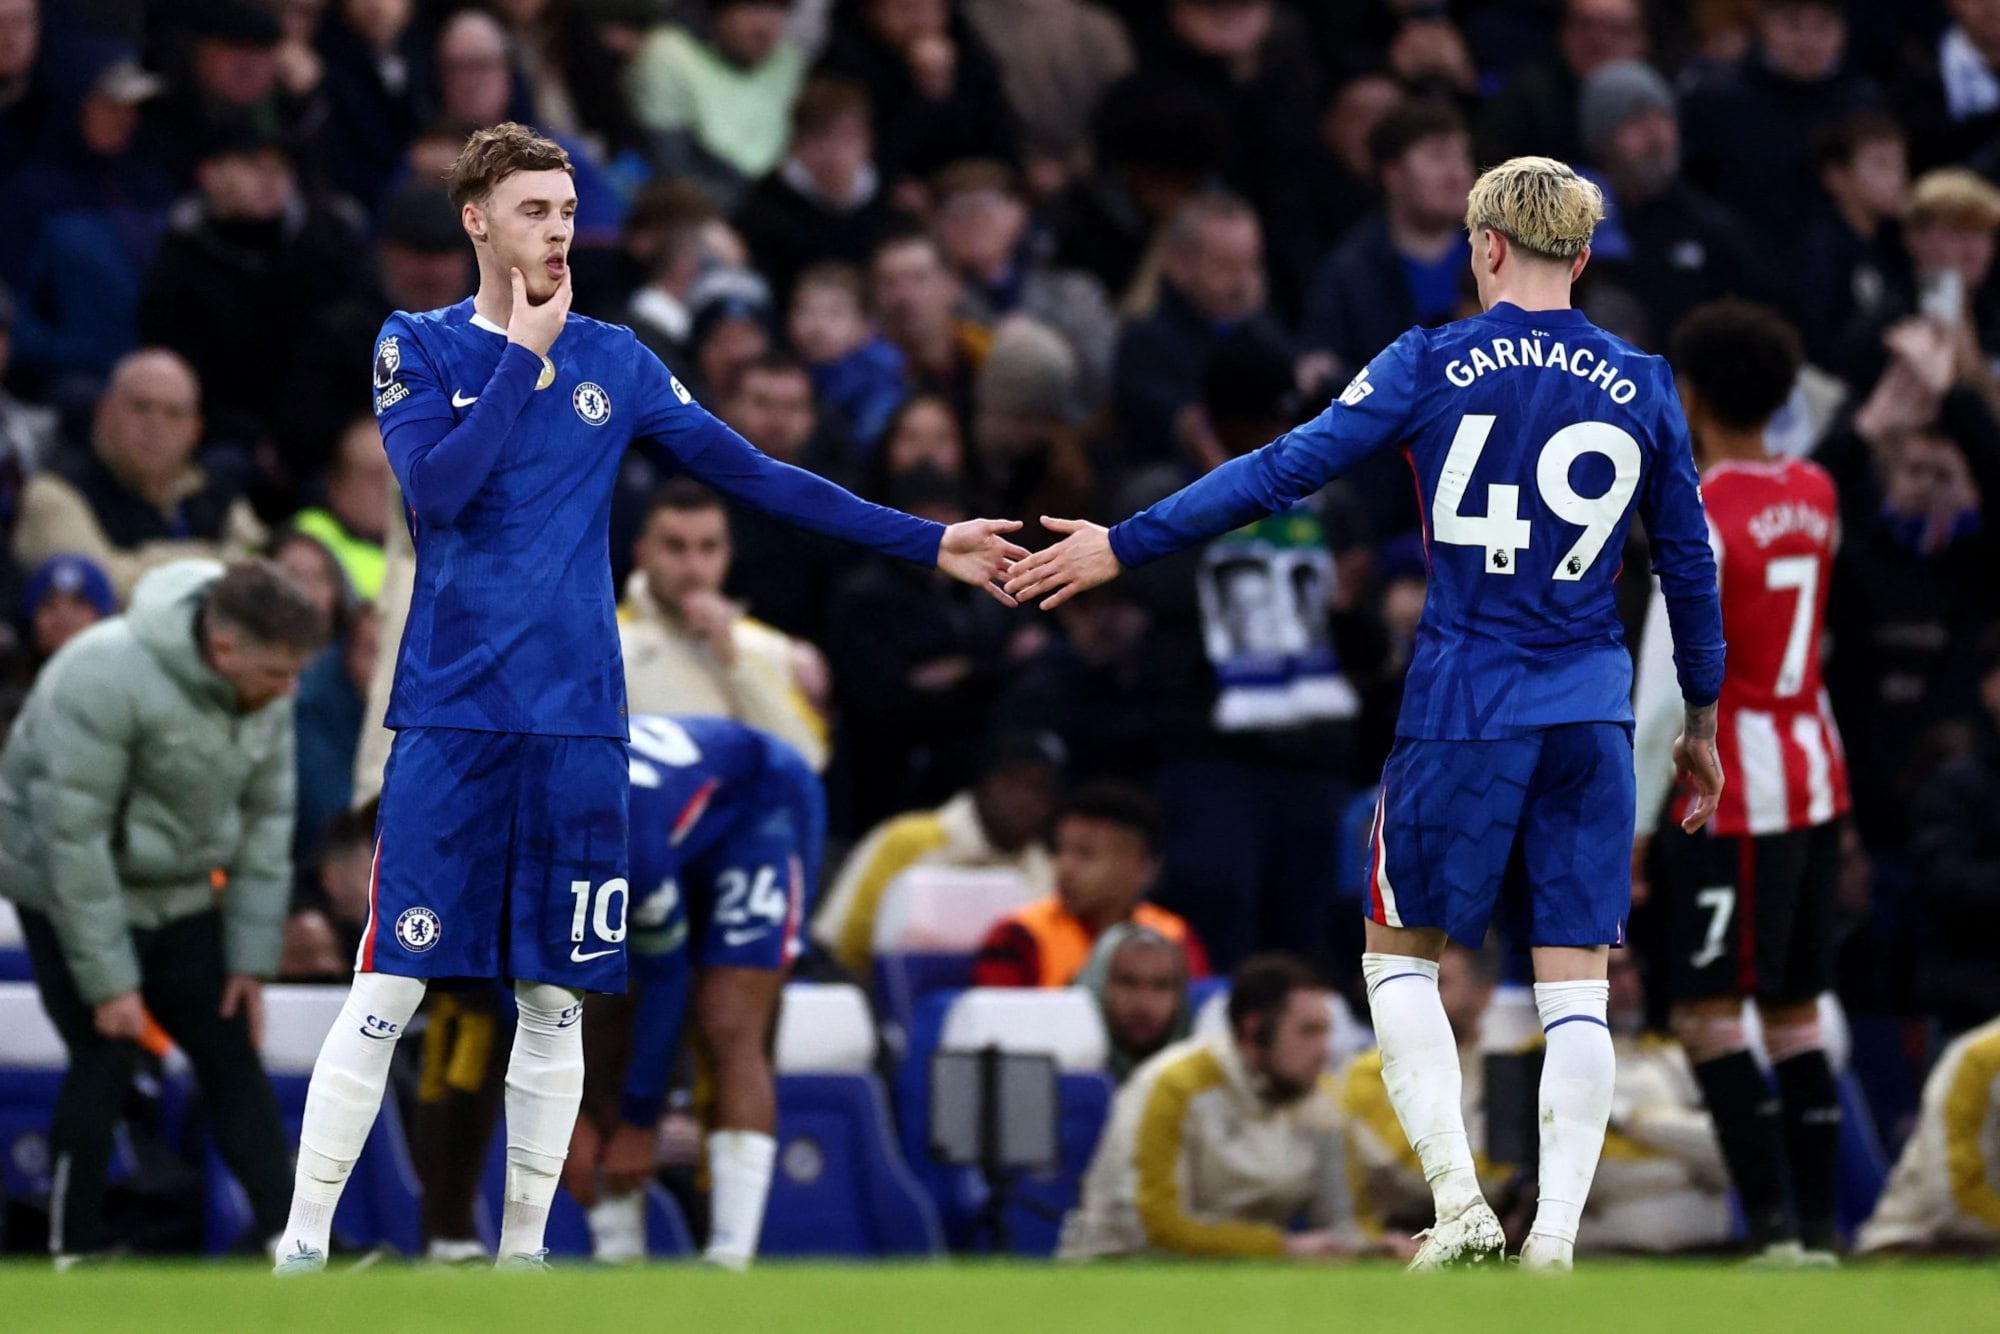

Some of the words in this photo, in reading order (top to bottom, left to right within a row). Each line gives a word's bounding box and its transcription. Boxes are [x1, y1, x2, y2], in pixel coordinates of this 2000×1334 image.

[1445, 338, 1637, 405] GARNACHO
[1432, 414, 1642, 581] 49
[1766, 555, 1820, 698] 7
[571, 878, 629, 943] 10
[714, 865, 787, 926] 24
[1696, 887, 1736, 957] 7
[366, 1015, 398, 1033] CFC
